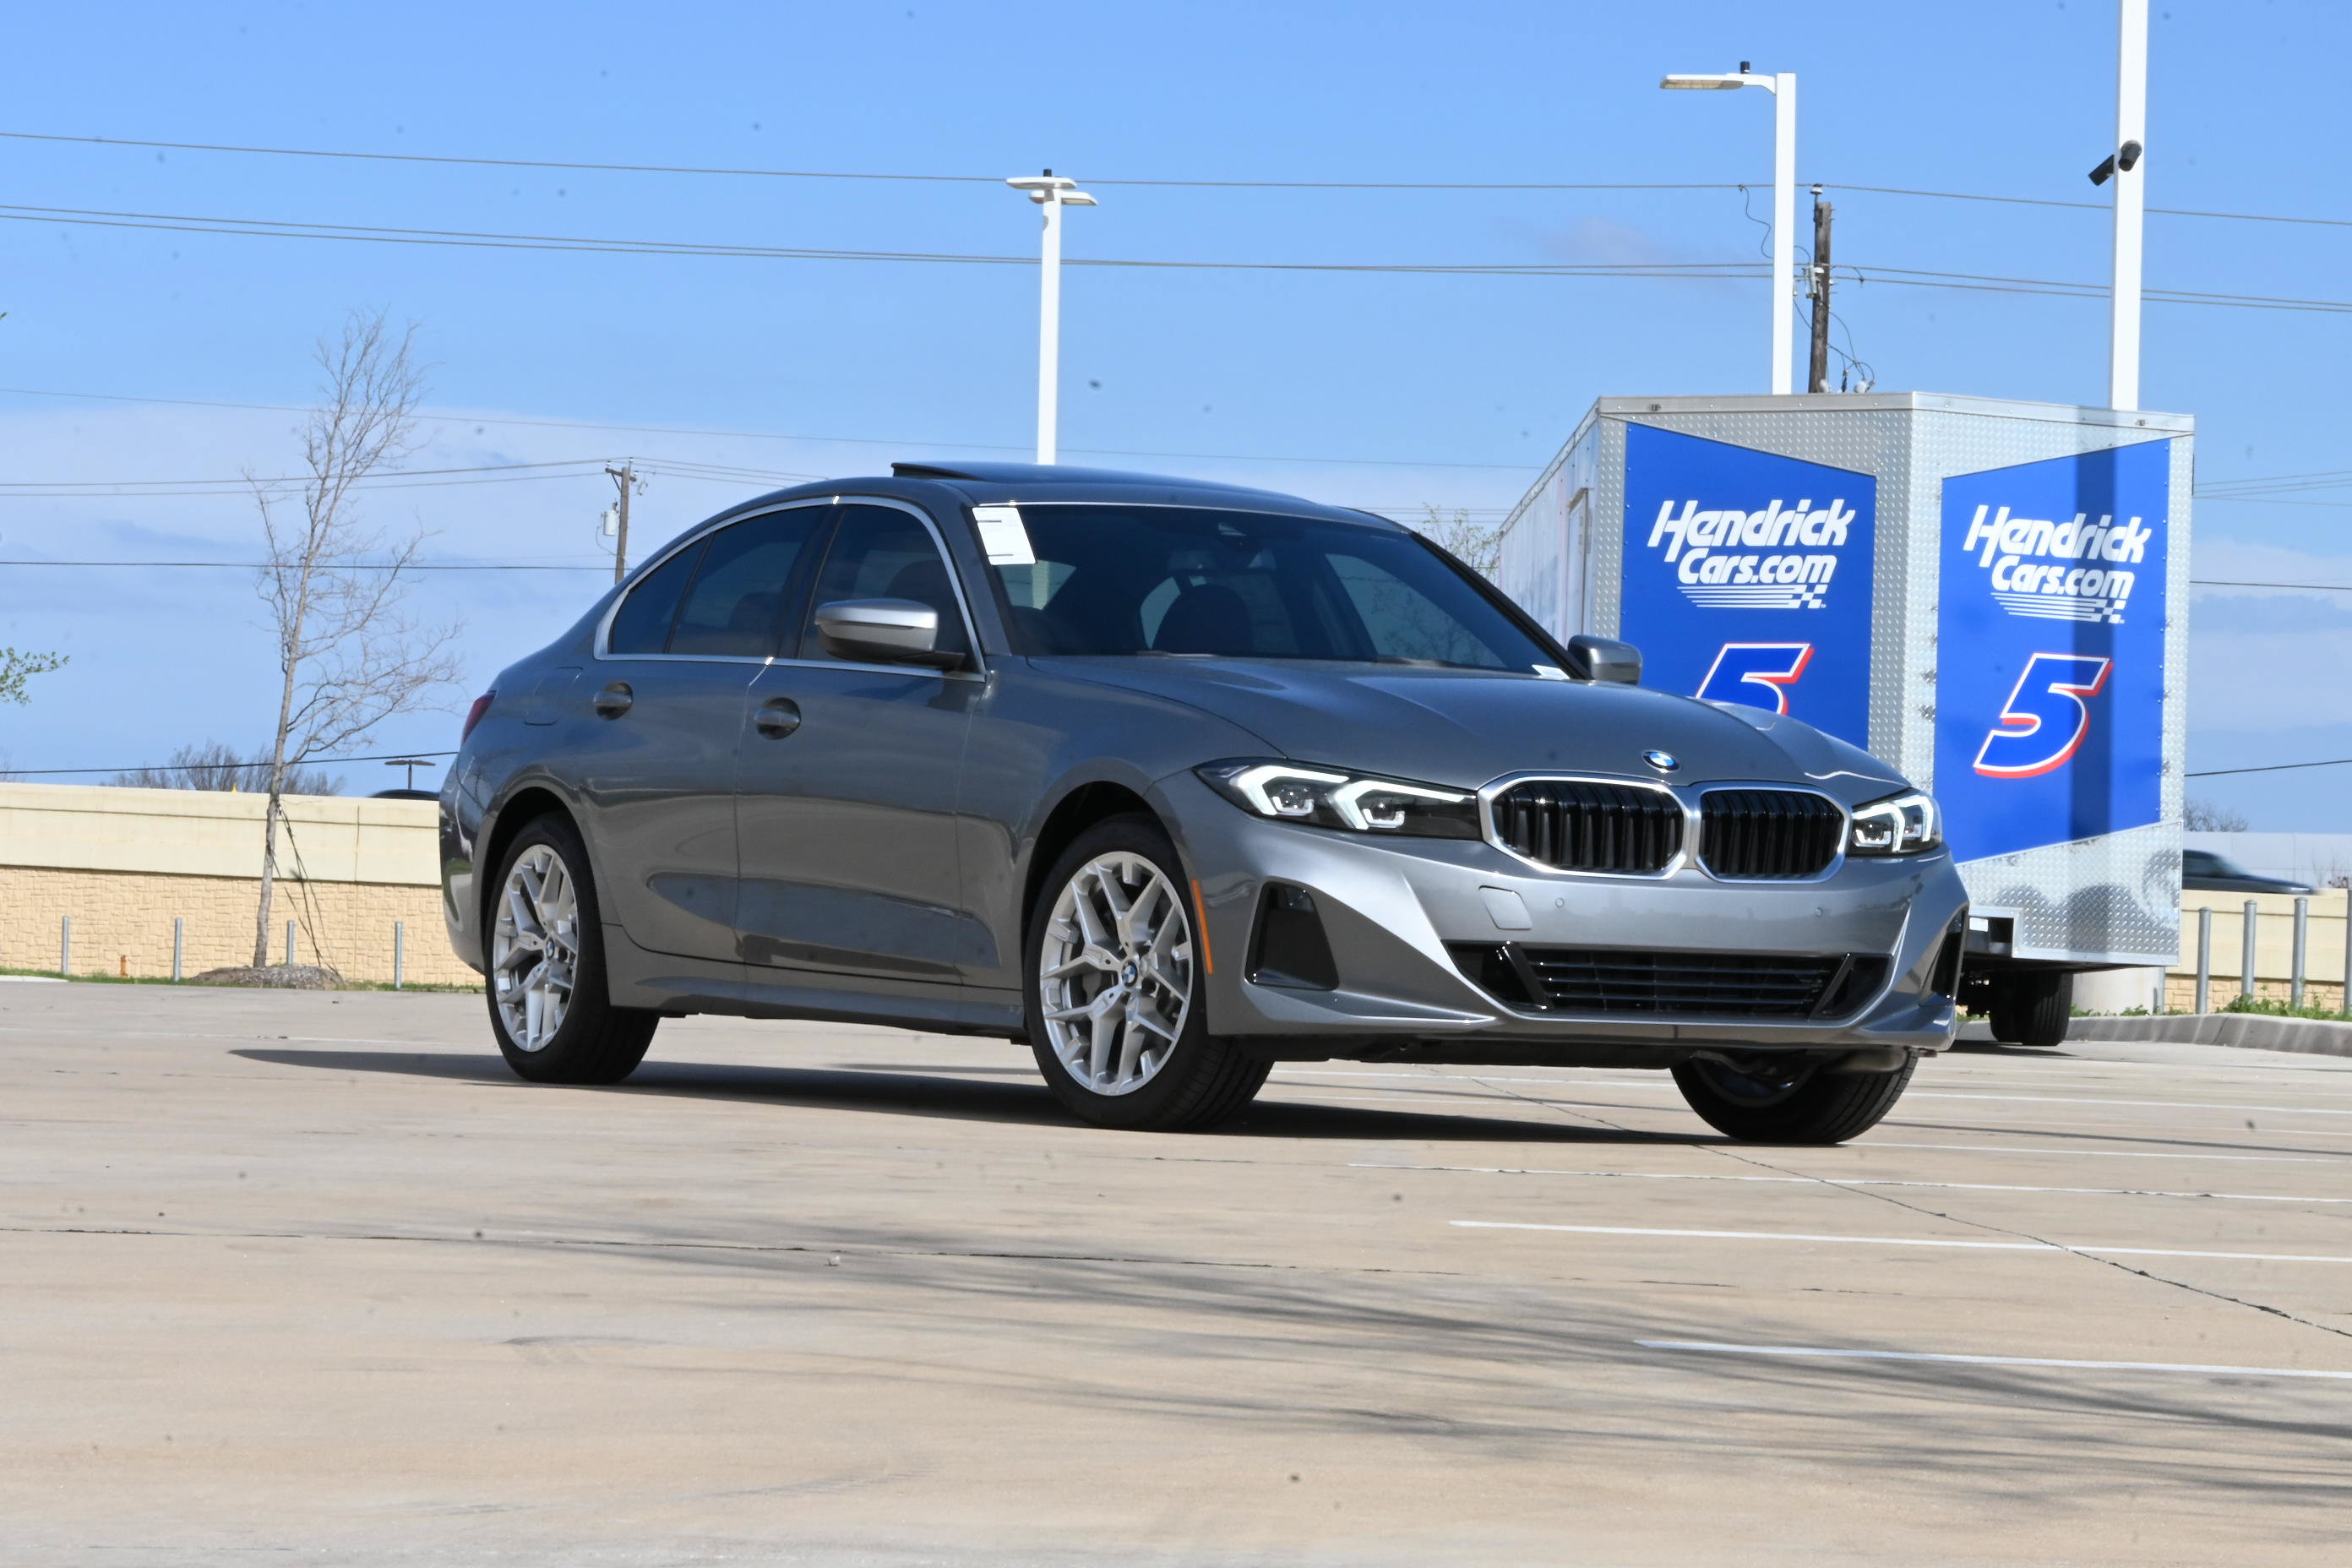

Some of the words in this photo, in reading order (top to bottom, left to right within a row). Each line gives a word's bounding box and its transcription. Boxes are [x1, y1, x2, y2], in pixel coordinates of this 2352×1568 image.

[1647, 499, 1856, 563] Hendrick
[1963, 504, 2152, 568] Hendrick
[1678, 547, 1838, 584] Cars.com
[1991, 555, 2135, 599] Cars.com
[1973, 652, 2114, 779] 5
